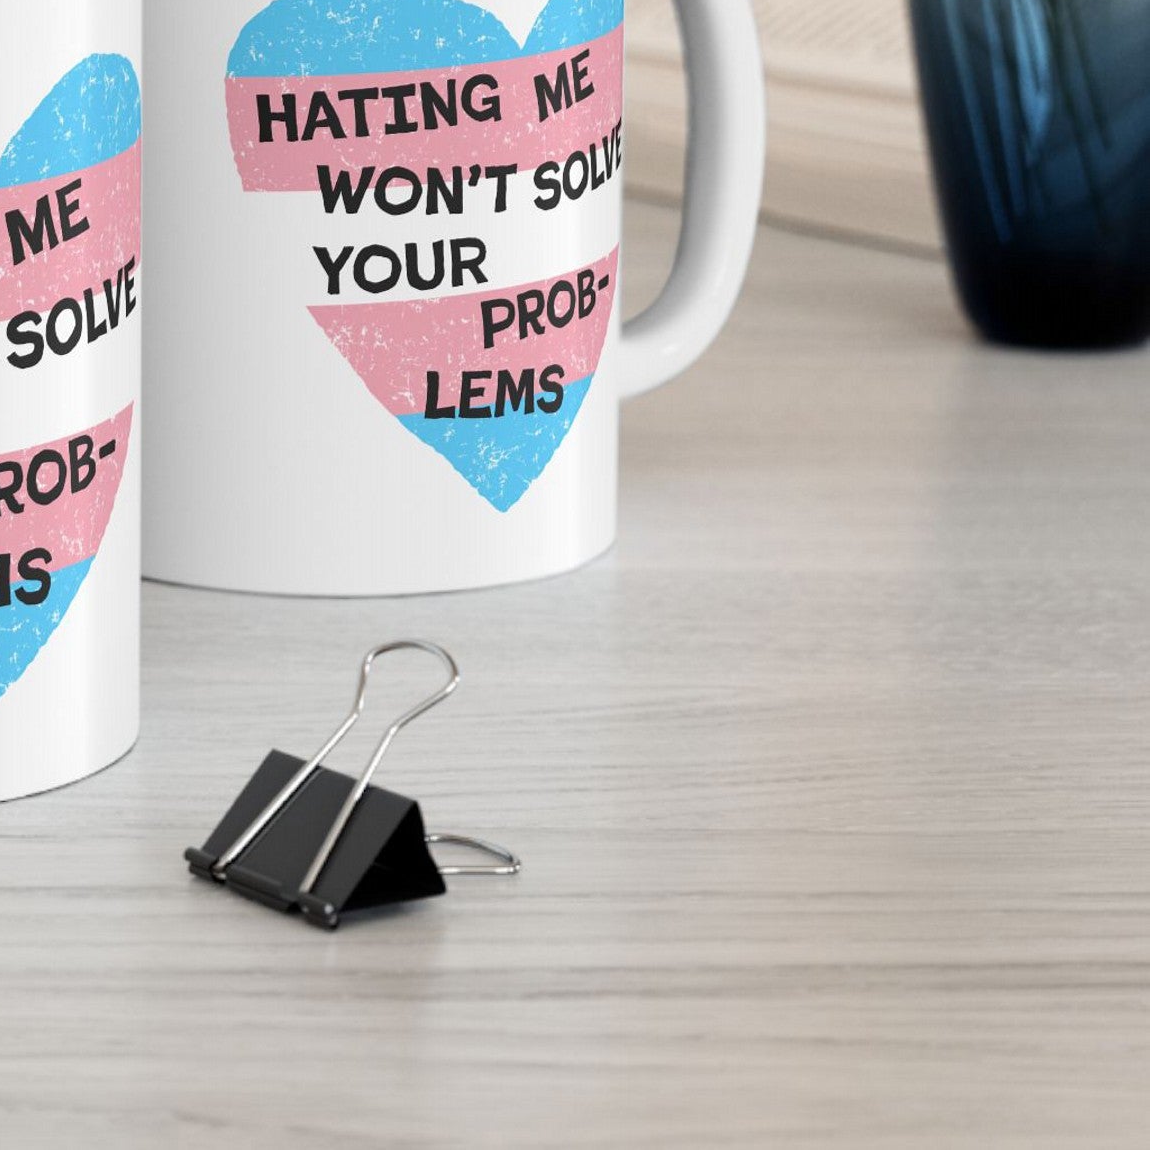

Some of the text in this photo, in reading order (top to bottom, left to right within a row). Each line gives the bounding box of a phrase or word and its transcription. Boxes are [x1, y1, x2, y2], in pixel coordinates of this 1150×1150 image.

[256, 49, 595, 143] HATING ME
[316, 116, 622, 216] WON'T SOLVE
[5, 178, 90, 266] ME
[312, 237, 489, 295] YOUR
[6, 256, 136, 369] SOLVE
[480, 269, 609, 349] PROB-
[424, 364, 565, 420] LEMS
